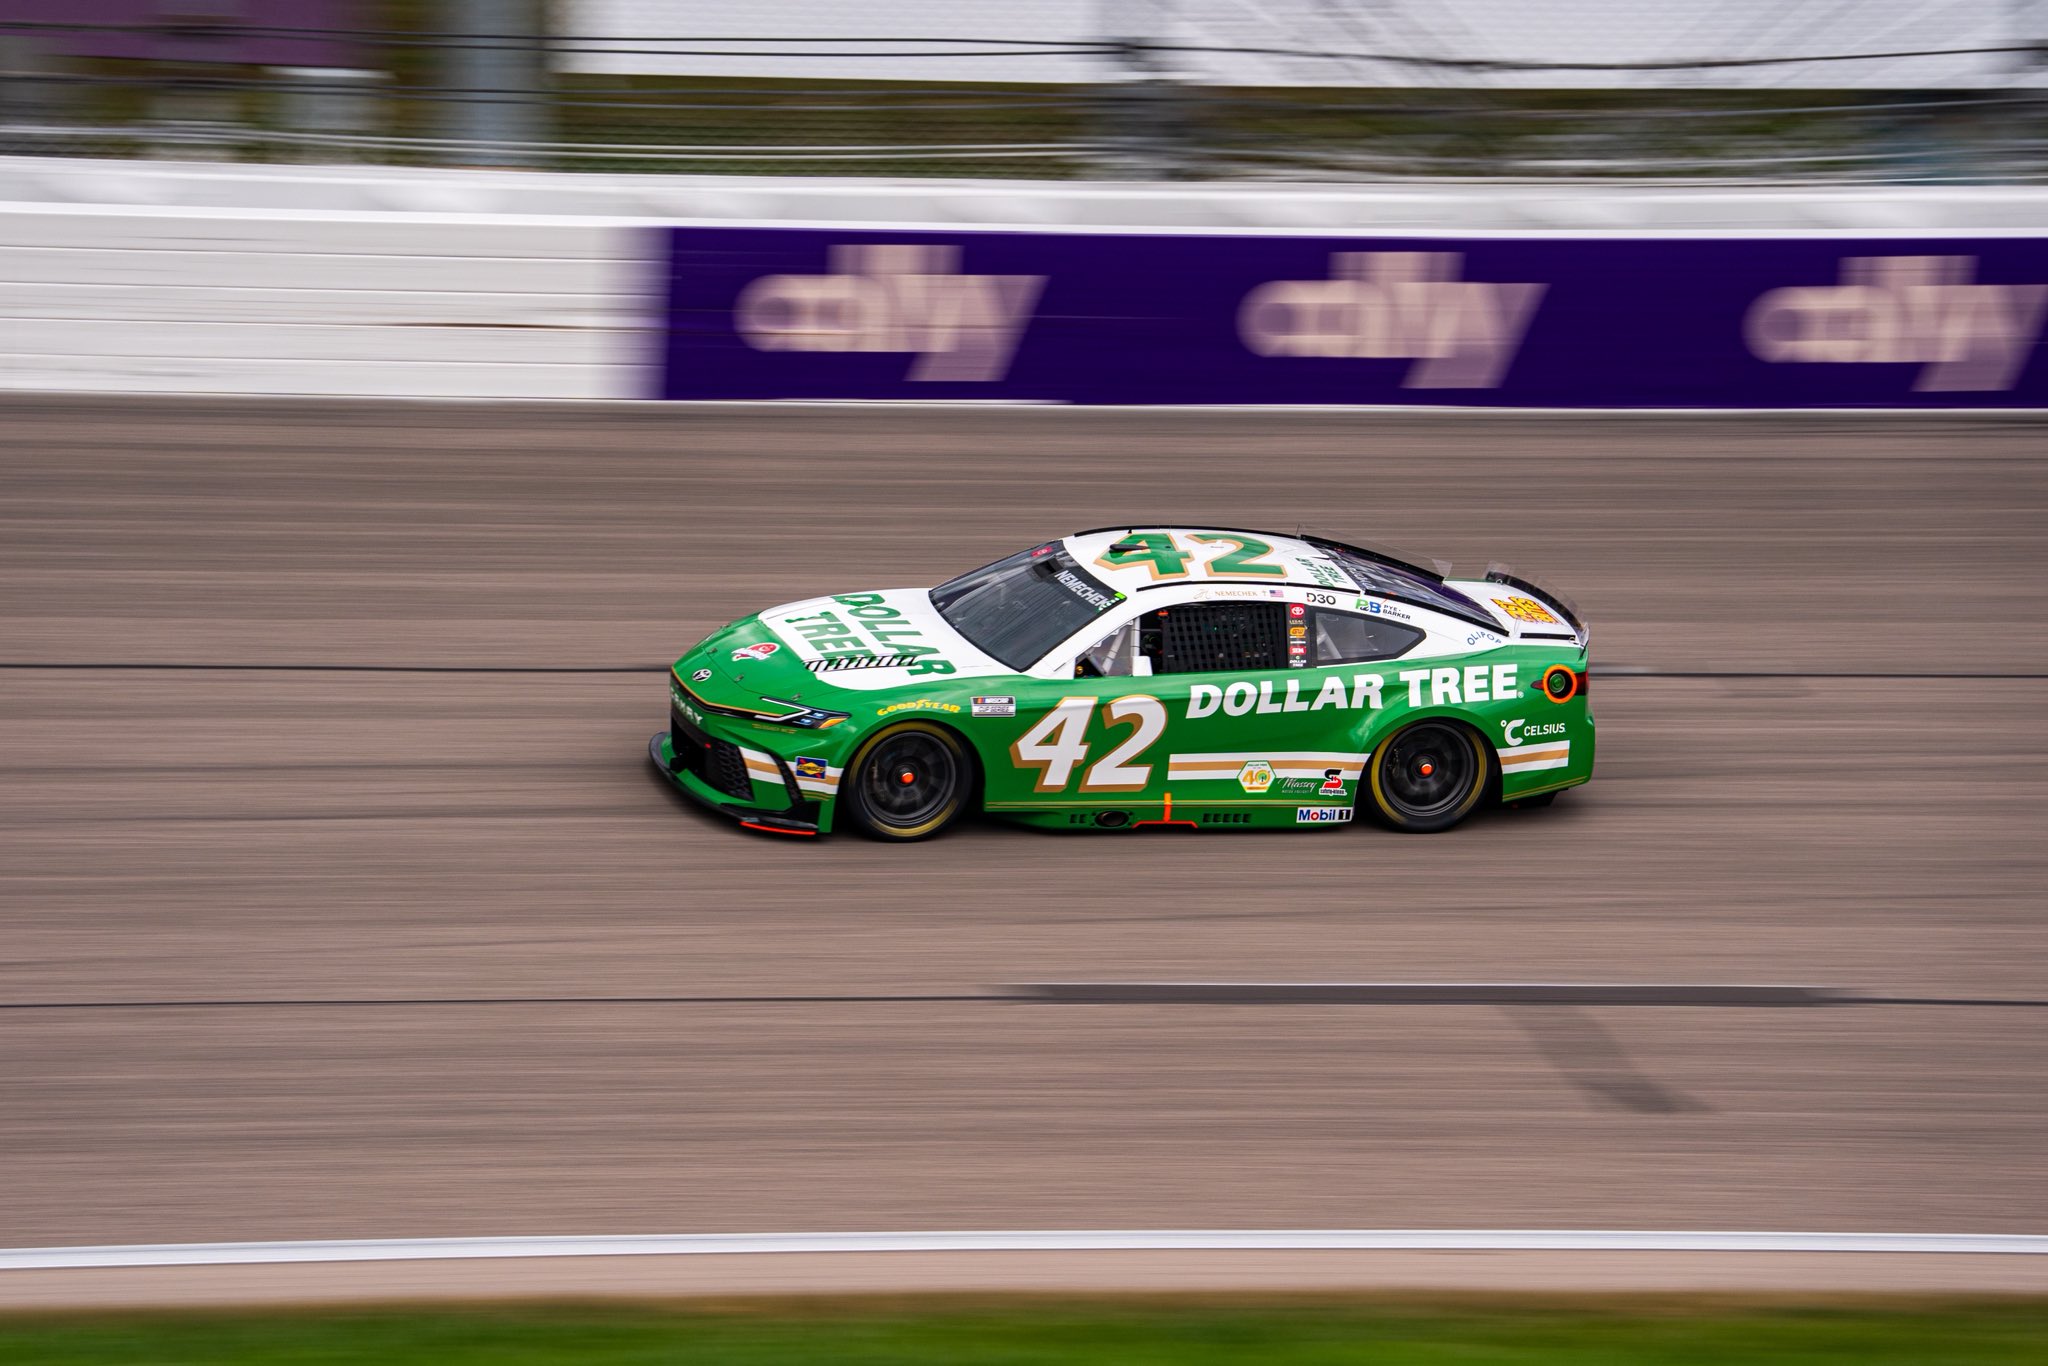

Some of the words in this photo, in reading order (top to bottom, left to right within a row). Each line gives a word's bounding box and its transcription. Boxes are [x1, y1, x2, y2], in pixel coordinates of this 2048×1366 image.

[1093, 533, 1288, 581] 42
[1382, 608, 1412, 620] BARKER
[830, 593, 957, 676] DOLLAR
[1467, 631, 1502, 646] OLIPOP
[1185, 673, 1384, 719] DOLLAR
[877, 698, 961, 716] GOODYEAR
[1523, 723, 1566, 737] CELSIUS
[1008, 694, 1169, 793] 42
[1299, 809, 1336, 821] Mobil
